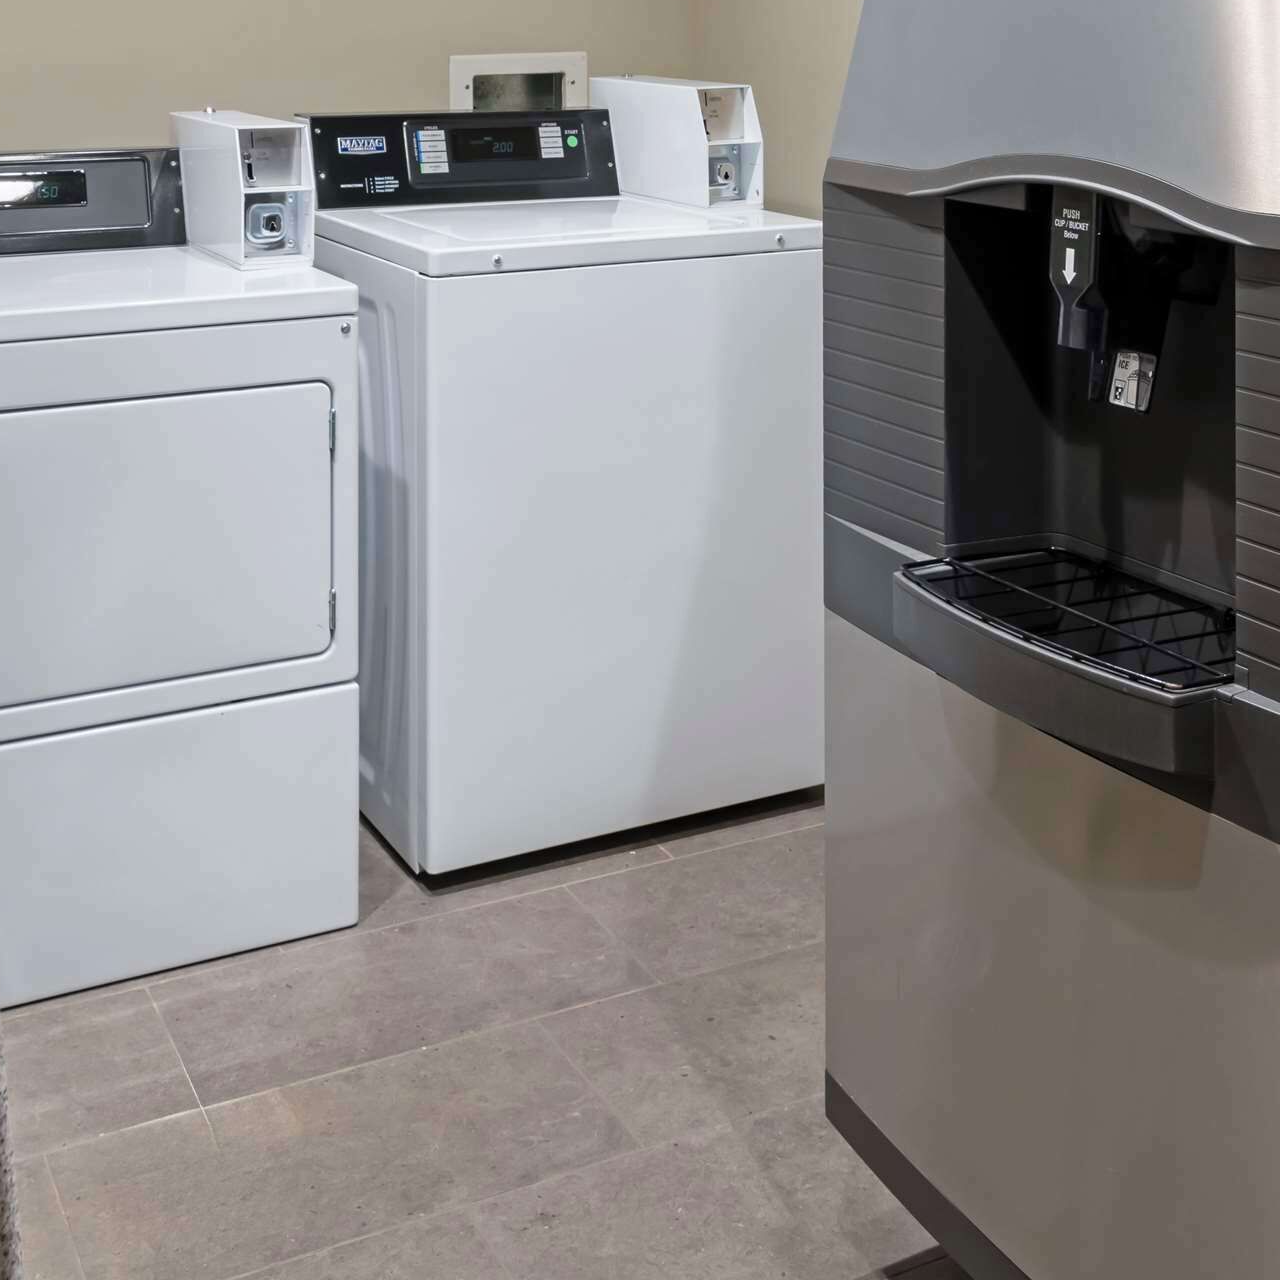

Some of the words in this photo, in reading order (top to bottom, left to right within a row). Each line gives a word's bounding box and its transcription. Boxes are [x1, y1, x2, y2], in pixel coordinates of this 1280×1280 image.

[340, 138, 383, 149] MAYTAG
[1062, 208, 1080, 220] PUSH
[1054, 218, 1066, 227] CUP
[1069, 220, 1089, 231] BUCKET
[1063, 230, 1079, 240] Below
[1118, 359, 1130, 370] ICE
